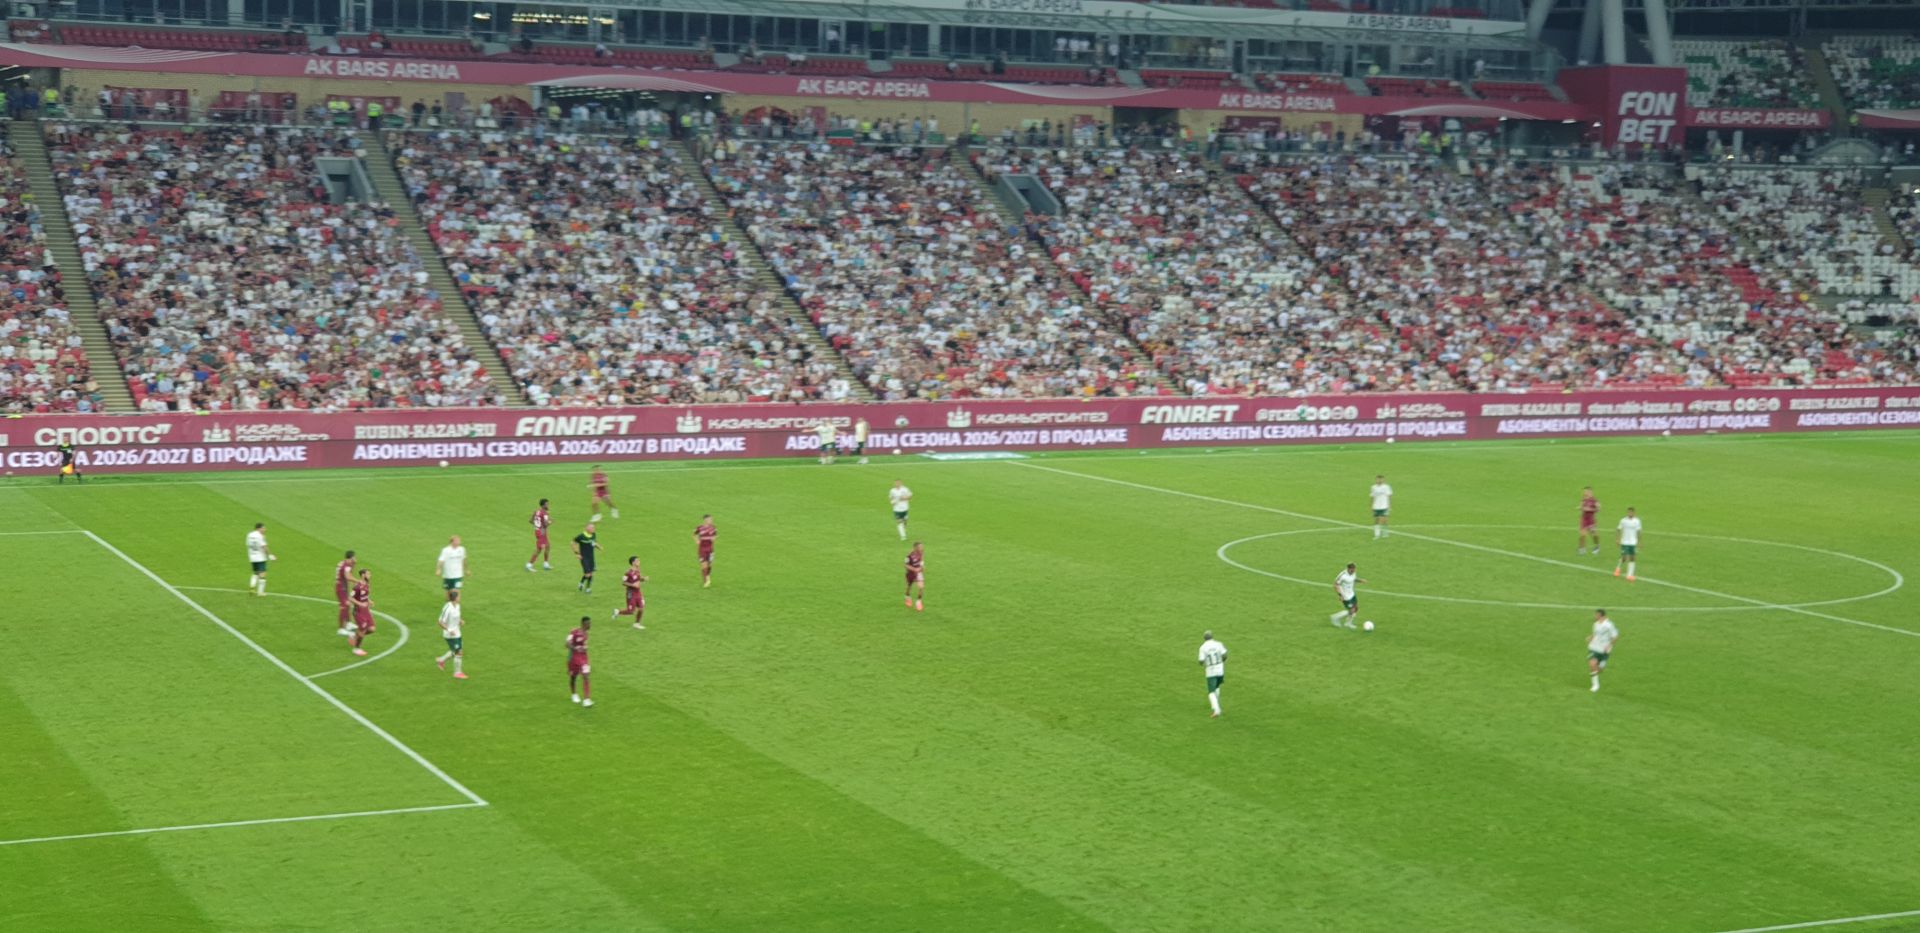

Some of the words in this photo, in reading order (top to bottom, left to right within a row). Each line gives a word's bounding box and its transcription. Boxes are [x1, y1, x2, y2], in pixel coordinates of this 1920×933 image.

[304, 59, 333, 75] AK
[336, 60, 389, 77] BARS
[391, 63, 461, 80] ARENA
[797, 79, 822, 93] АК
[824, 80, 870, 96] БАРС
[871, 82, 930, 97] АРЕНА
[1219, 94, 1241, 108] AK
[1242, 94, 1283, 109] BARS
[1284, 97, 1336, 111] ARENA
[1619, 92, 1677, 117] FON
[1695, 110, 1718, 123] АК
[1720, 111, 1763, 125] БАРС
[1764, 112, 1821, 126] АРЕНА
[1618, 119, 1677, 143] BET
[1140, 404, 1240, 424] FONBET
[1497, 418, 1589, 433] АБОНЕМЕНТЫ
[1589, 417, 1639, 431] СЕЗОНА
[1709, 414, 1772, 429] ПРОДАЖЕ
[354, 423, 497, 440] RUBIN-KAZANRU
[515, 414, 637, 437] FONBET
[1161, 426, 1261, 441] АБОНЕМЕНТЫ
[1262, 424, 1319, 439] СЕЗОНА
[1319, 423, 1386, 437] 2026/2027
[1386, 423, 1397, 436] В
[1398, 421, 1467, 436] ПРОДАЖЕ
[353, 442, 484, 460] АБОНЕМЕНТЫ
[486, 440, 558, 457] СЕЗОНА
[559, 439, 643, 455] 2026/2027
[645, 438, 659, 453] В
[660, 437, 746, 454] ПРОДАЖЕ
[900, 432, 962, 448] СЕЗОНА
[963, 431, 1038, 445] 2026/2027
[1039, 430, 1051, 444] В
[1052, 429, 1128, 445] ПРОДАЖЕ
[7, 450, 91, 468] СЕЗОА
[92, 447, 189, 466] 2026/2027
[192, 446, 207, 464] В
[208, 445, 308, 465] ПРОДАЖЕ
[1206, 653, 1222, 666] 11
